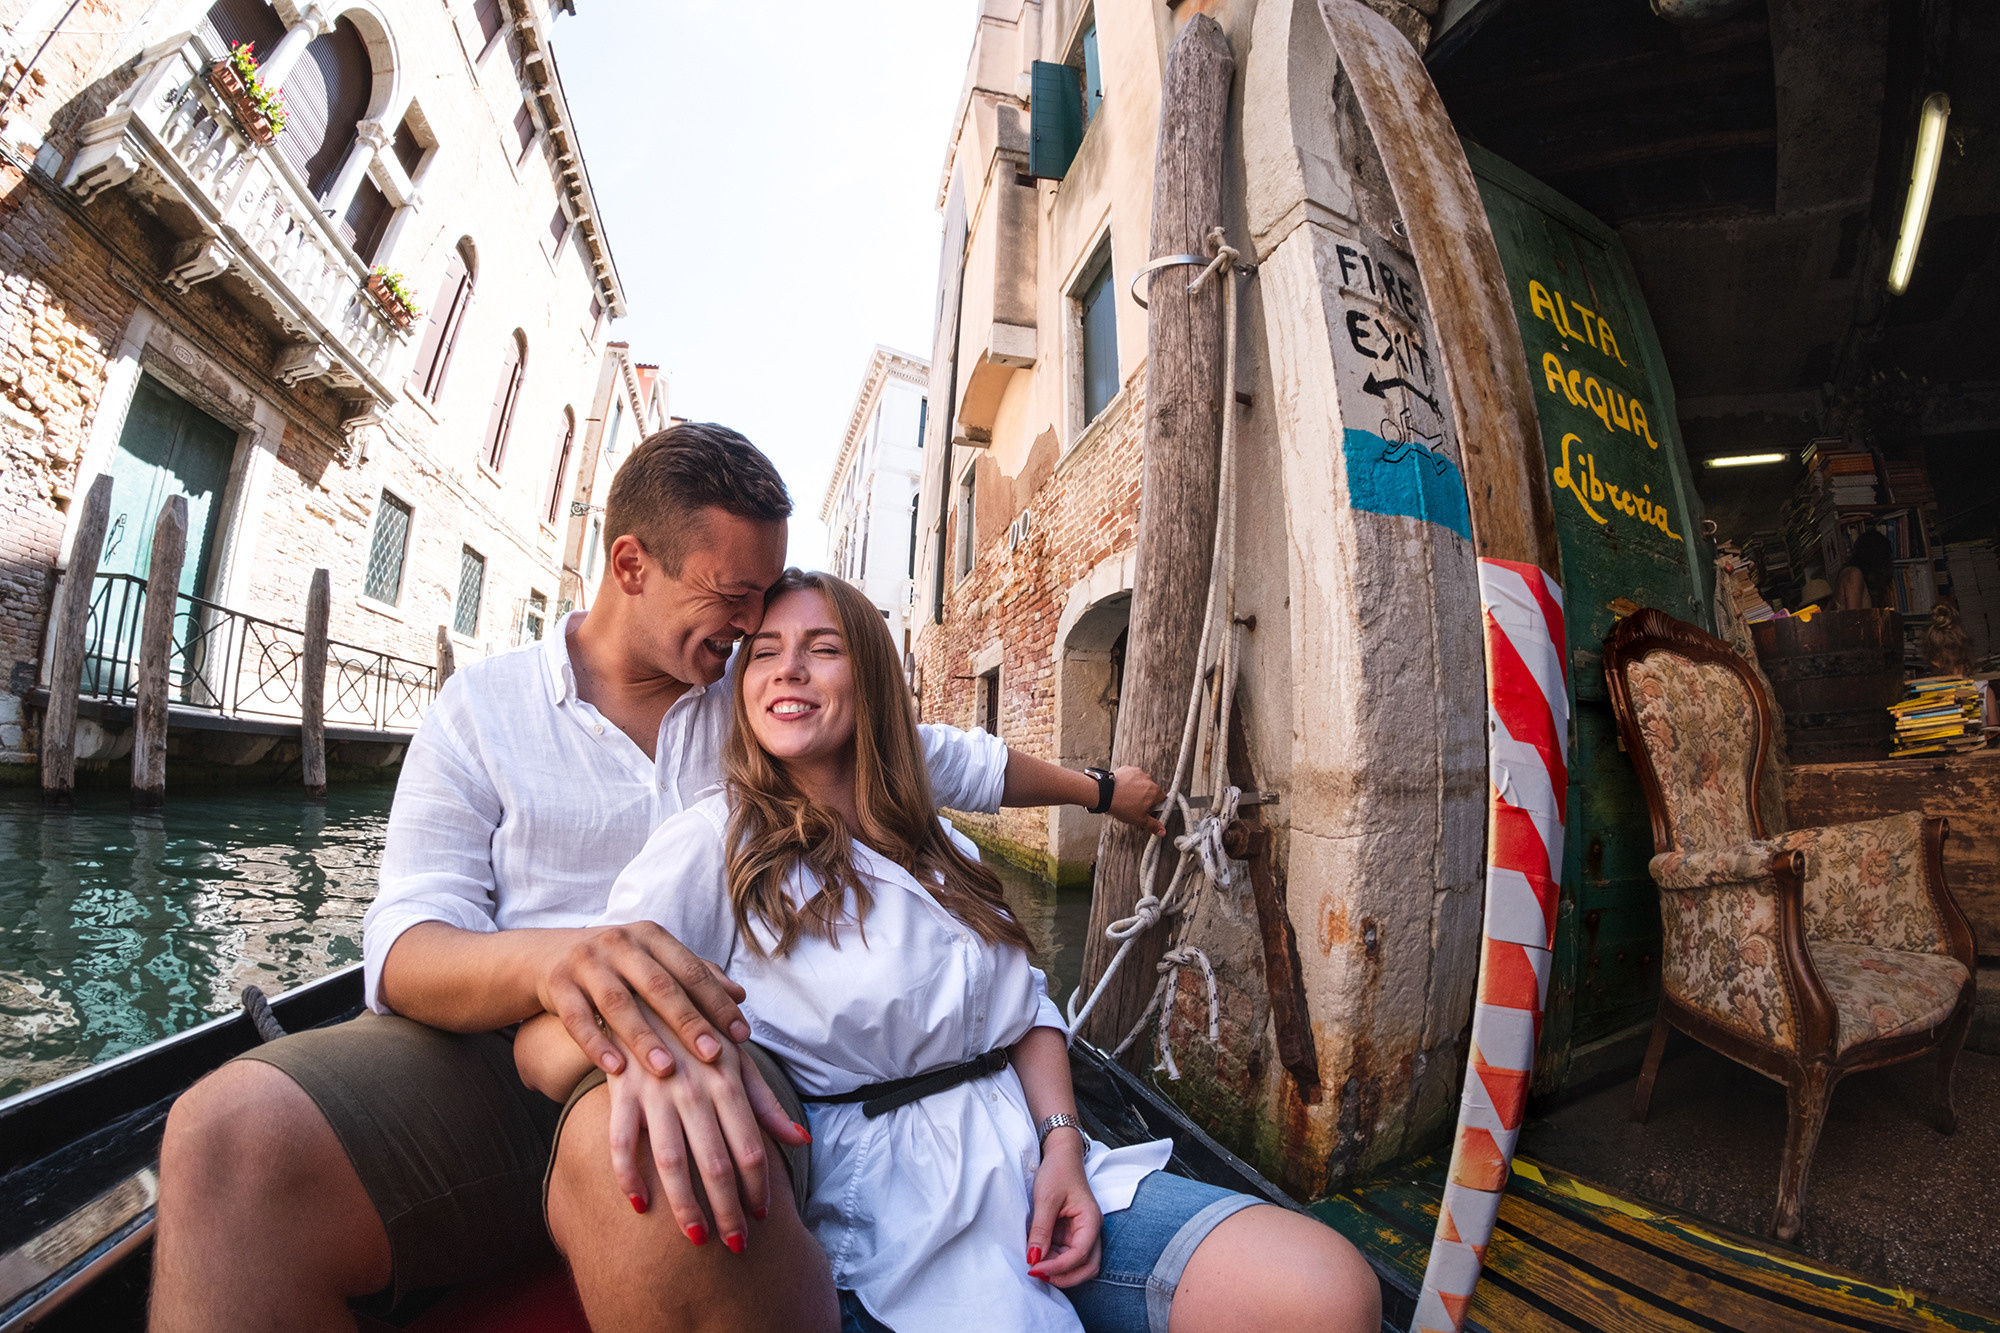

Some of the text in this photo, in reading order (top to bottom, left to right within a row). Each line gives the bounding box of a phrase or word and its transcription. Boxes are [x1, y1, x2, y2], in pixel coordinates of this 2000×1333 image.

[1336, 244, 1418, 324] FIRE
[1529, 279, 1627, 368] ALTA
[1346, 310, 1429, 386] EXIT
[1542, 352, 1658, 450] ACQUA
[1553, 432, 1684, 543] Libreria
